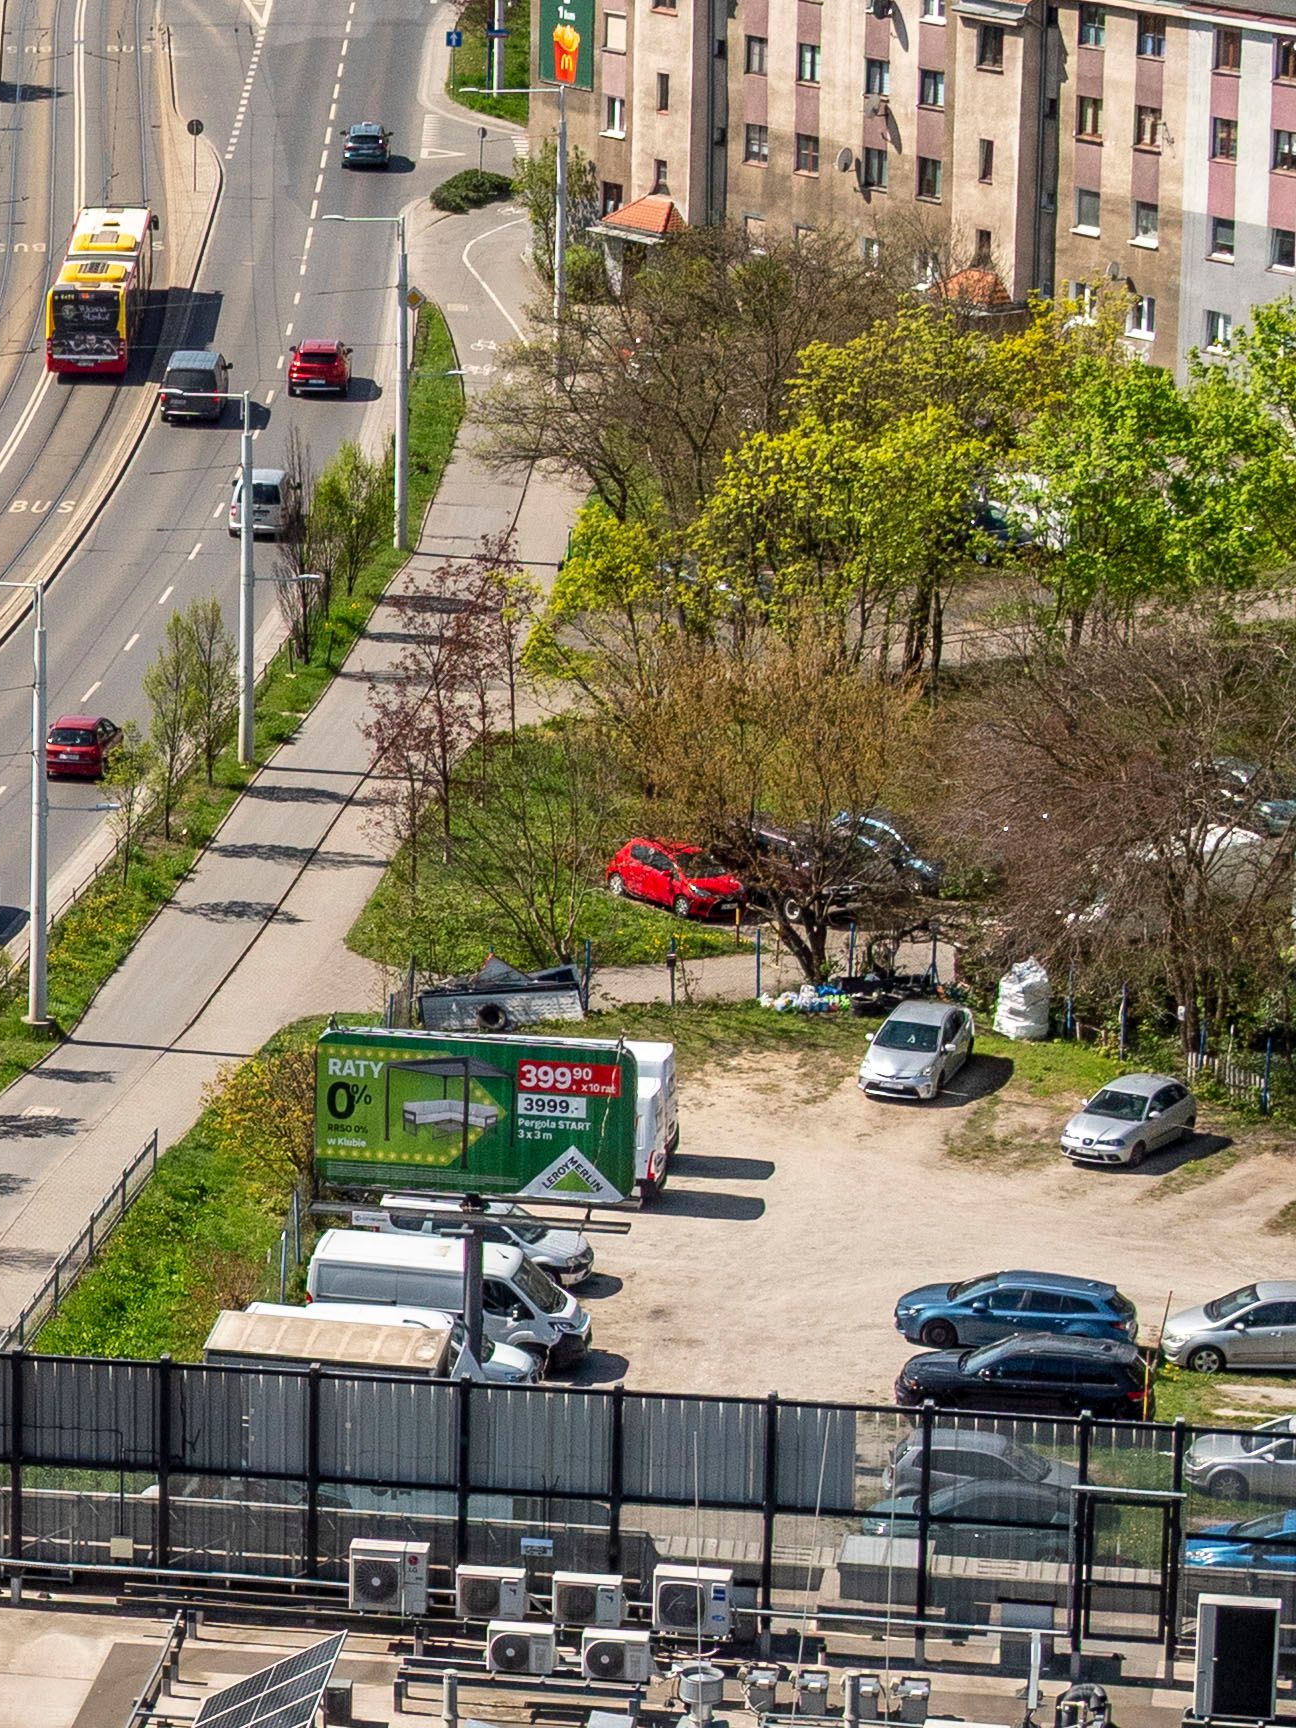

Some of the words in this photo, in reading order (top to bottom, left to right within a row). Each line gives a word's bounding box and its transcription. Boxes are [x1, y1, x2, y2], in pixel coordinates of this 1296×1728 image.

[8, 499, 77, 514] BUS
[327, 1058, 384, 1079] RATY
[327, 1123, 350, 1134] RRSO
[517, 1117, 556, 1131] Pergola
[557, 1120, 592, 1131] START
[336, 1137, 367, 1148] Klubie
[541, 1163, 571, 1190] LEROY
[566, 1156, 605, 1193] MERLIN
